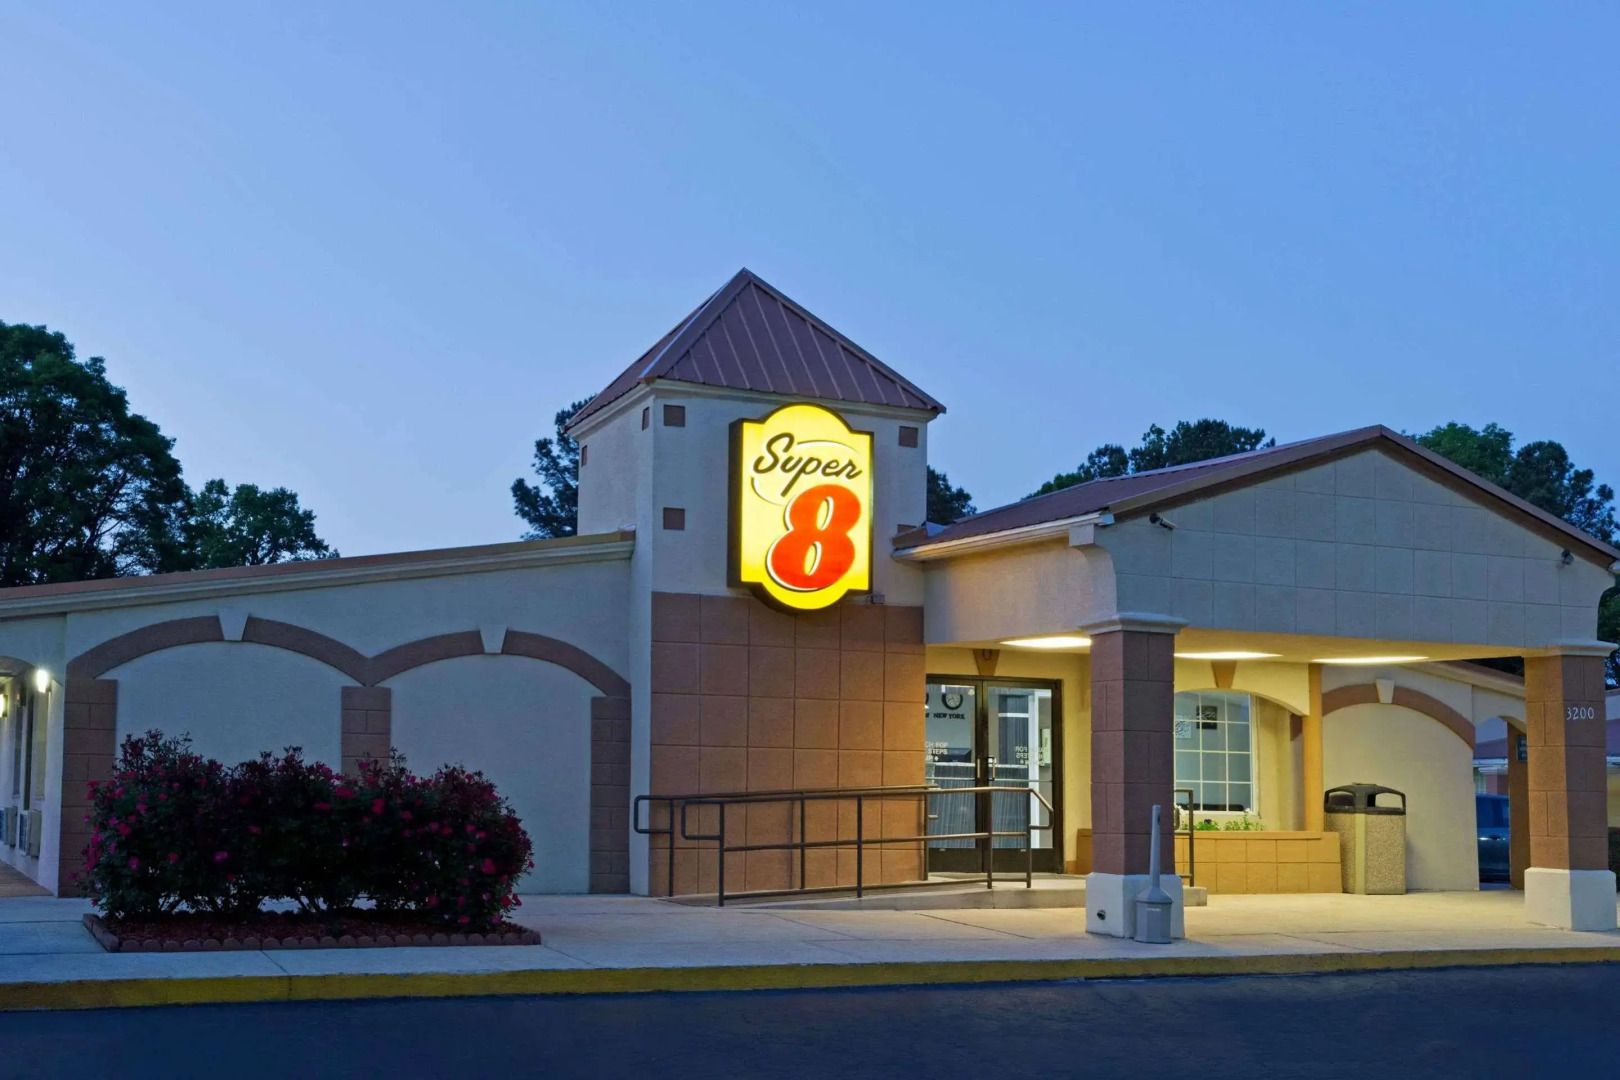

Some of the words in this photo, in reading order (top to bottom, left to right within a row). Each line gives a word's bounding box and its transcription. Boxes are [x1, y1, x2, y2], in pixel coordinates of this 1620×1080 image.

[753, 432, 862, 497] Super
[765, 484, 861, 592] 8
[1566, 706, 1594, 720] 3200
